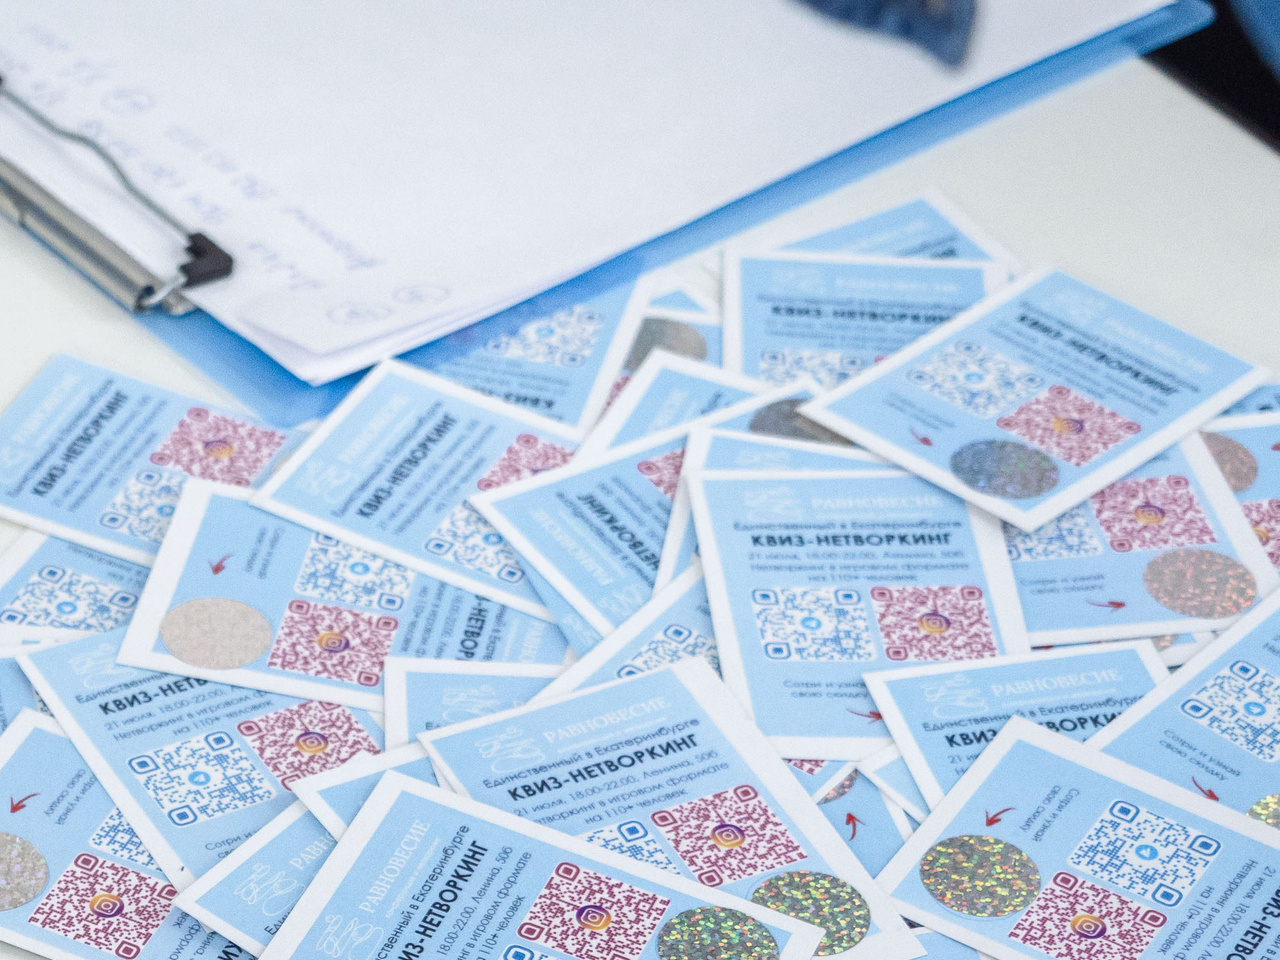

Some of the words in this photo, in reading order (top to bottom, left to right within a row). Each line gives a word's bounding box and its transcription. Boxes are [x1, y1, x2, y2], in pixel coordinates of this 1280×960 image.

[29, 388, 131, 496] КВИЗ-НЕТВОРКИНГ
[355, 411, 459, 518] КВИЗ-НЕТВОРКИНГ
[751, 532, 953, 546] КВИЗ-НЕТВОРКИНГ
[74, 669, 169, 705] Единственны
[541, 696, 674, 744] РАВНОВЕСИЕ
[921, 708, 1027, 731] Единственн
[482, 752, 584, 789] Единственный
[593, 718, 701, 756] Екатеринбурге
[506, 732, 699, 802] КВИЗ-НЕТВОРКИНГ
[513, 806, 529, 818] 21
[530, 797, 568, 812] июля,
[568, 774, 640, 801] 18.00-22.00,
[642, 759, 694, 780] Ленина,
[527, 802, 597, 828] етворкинг
[606, 782, 665, 804] игровом
[665, 762, 730, 787] формате
[583, 813, 604, 825] на
[603, 803, 635, 818] 110+
[635, 788, 689, 808] человек
[1041, 786, 1061, 806] свою
[1054, 789, 1080, 813] Сотри
[1018, 805, 1045, 833] скидку
[1031, 818, 1054, 842] узнай
[355, 818, 433, 915] РАВНОВЕСИЕ
[410, 824, 470, 903] Екатеринбурге
[495, 851, 532, 899] формате
[1215, 858, 1261, 908] Нетворкинг
[1262, 865, 1278, 878] 21
[408, 902, 420, 911] в
[1200, 885, 1216, 899] на
[1243, 876, 1268, 900] июля,
[435, 905, 477, 956] 18.00-22.00,
[470, 866, 503, 904] Ленина,
[469, 900, 502, 942] игровом
[477, 932, 499, 955] 110+
[494, 894, 526, 932] человек
[1186, 899, 1208, 920] 110+
[1206, 902, 1251, 948] 18.00-22.00,
[464, 941, 476, 949] в
[1156, 920, 1190, 955] человек
[1180, 912, 1217, 952] игровом
